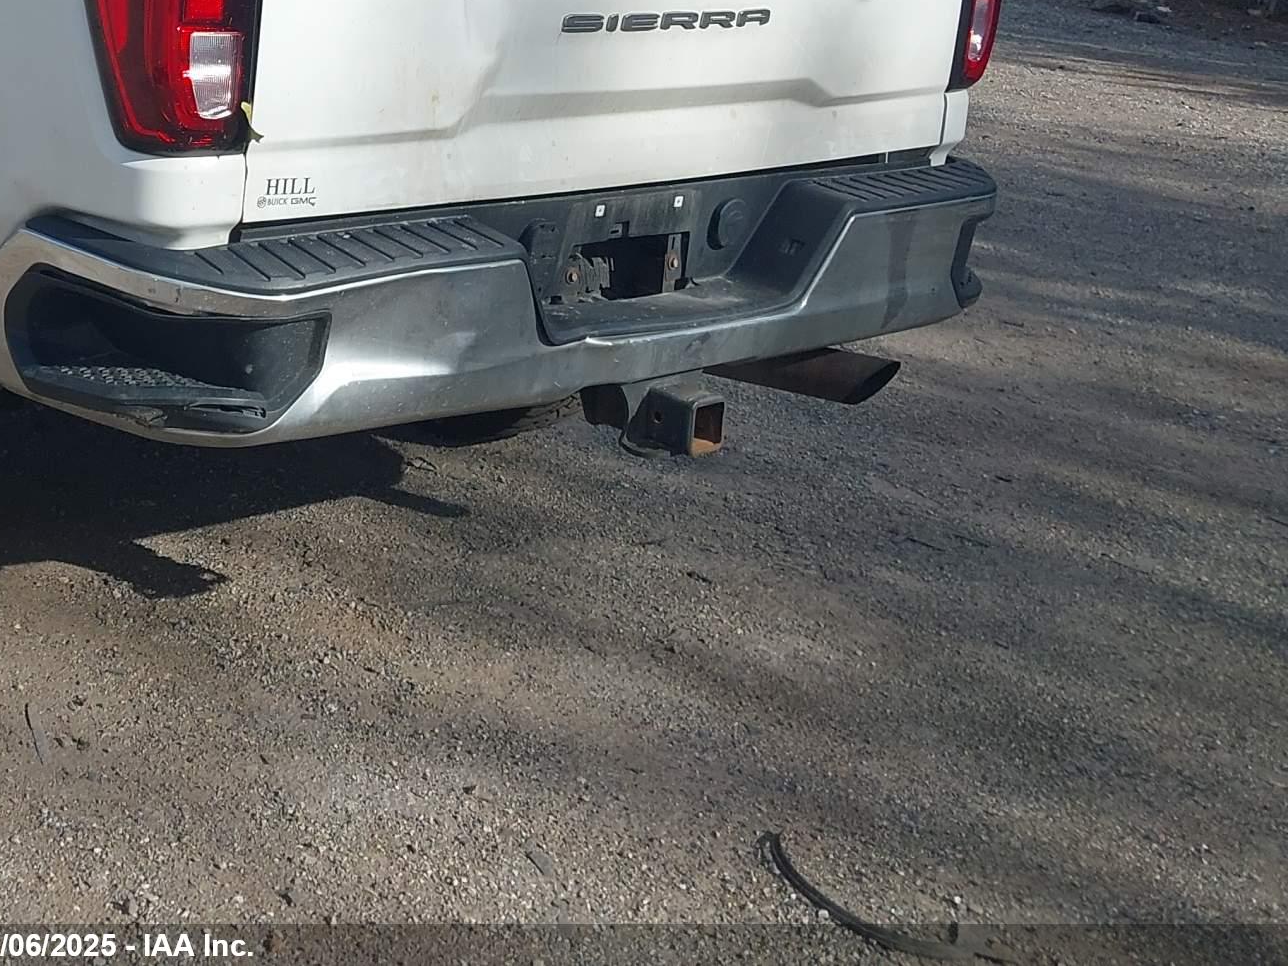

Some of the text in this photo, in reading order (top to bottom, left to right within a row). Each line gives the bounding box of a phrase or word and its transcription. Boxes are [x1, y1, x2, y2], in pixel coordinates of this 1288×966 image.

[562, 9, 770, 33] SIERRA
[266, 177, 315, 195] HILL
[291, 196, 317, 206] GMC
